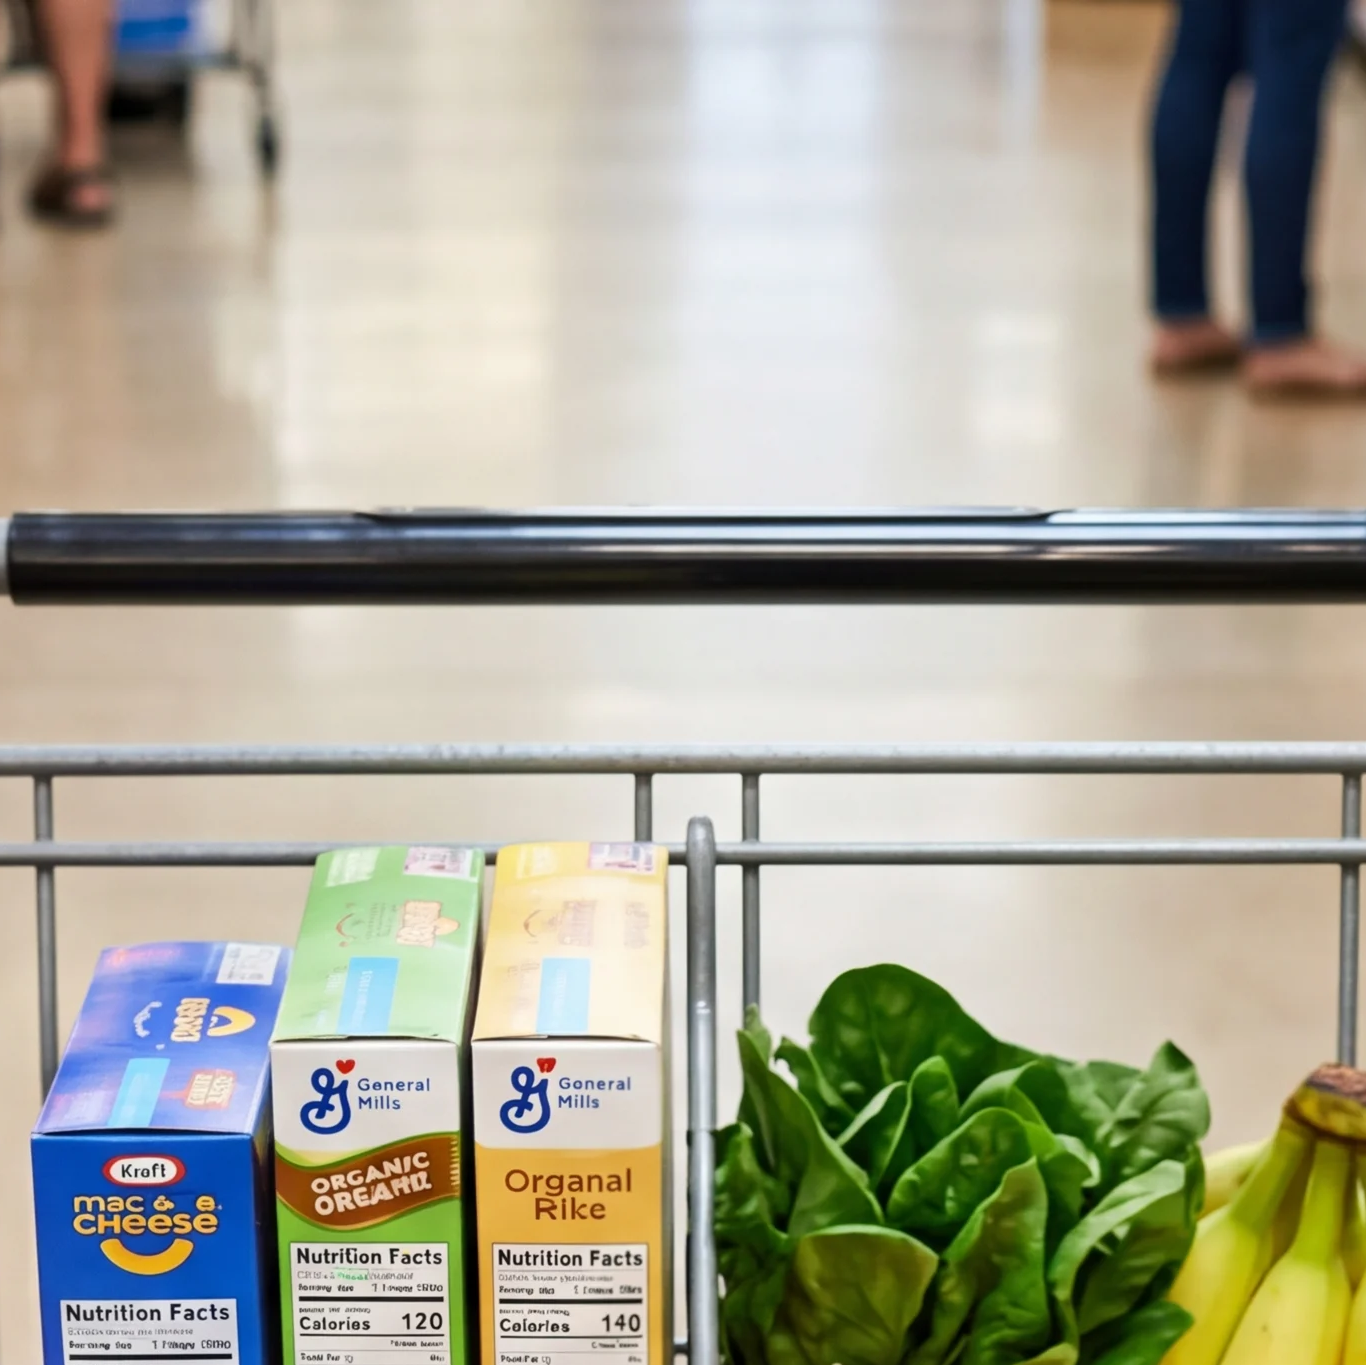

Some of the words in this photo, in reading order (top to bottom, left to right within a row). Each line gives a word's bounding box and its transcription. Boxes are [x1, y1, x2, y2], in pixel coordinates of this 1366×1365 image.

[357, 1095, 401, 1110] Mills
[557, 1094, 601, 1109] Mills
[310, 1151, 431, 1195] ORGANIC
[504, 1167, 633, 1197] Organal
[73, 1195, 145, 1213] mac
[534, 1196, 607, 1221] Rike
[296, 1246, 383, 1266] Nutrition
[389, 1247, 443, 1266] Facts
[497, 1248, 583, 1267] Nutrition
[589, 1249, 643, 1267] Facts
[65, 1303, 162, 1321] Nutrition
[169, 1303, 230, 1321] Facts
[401, 1312, 443, 1331] 120
[601, 1313, 642, 1333] 140
